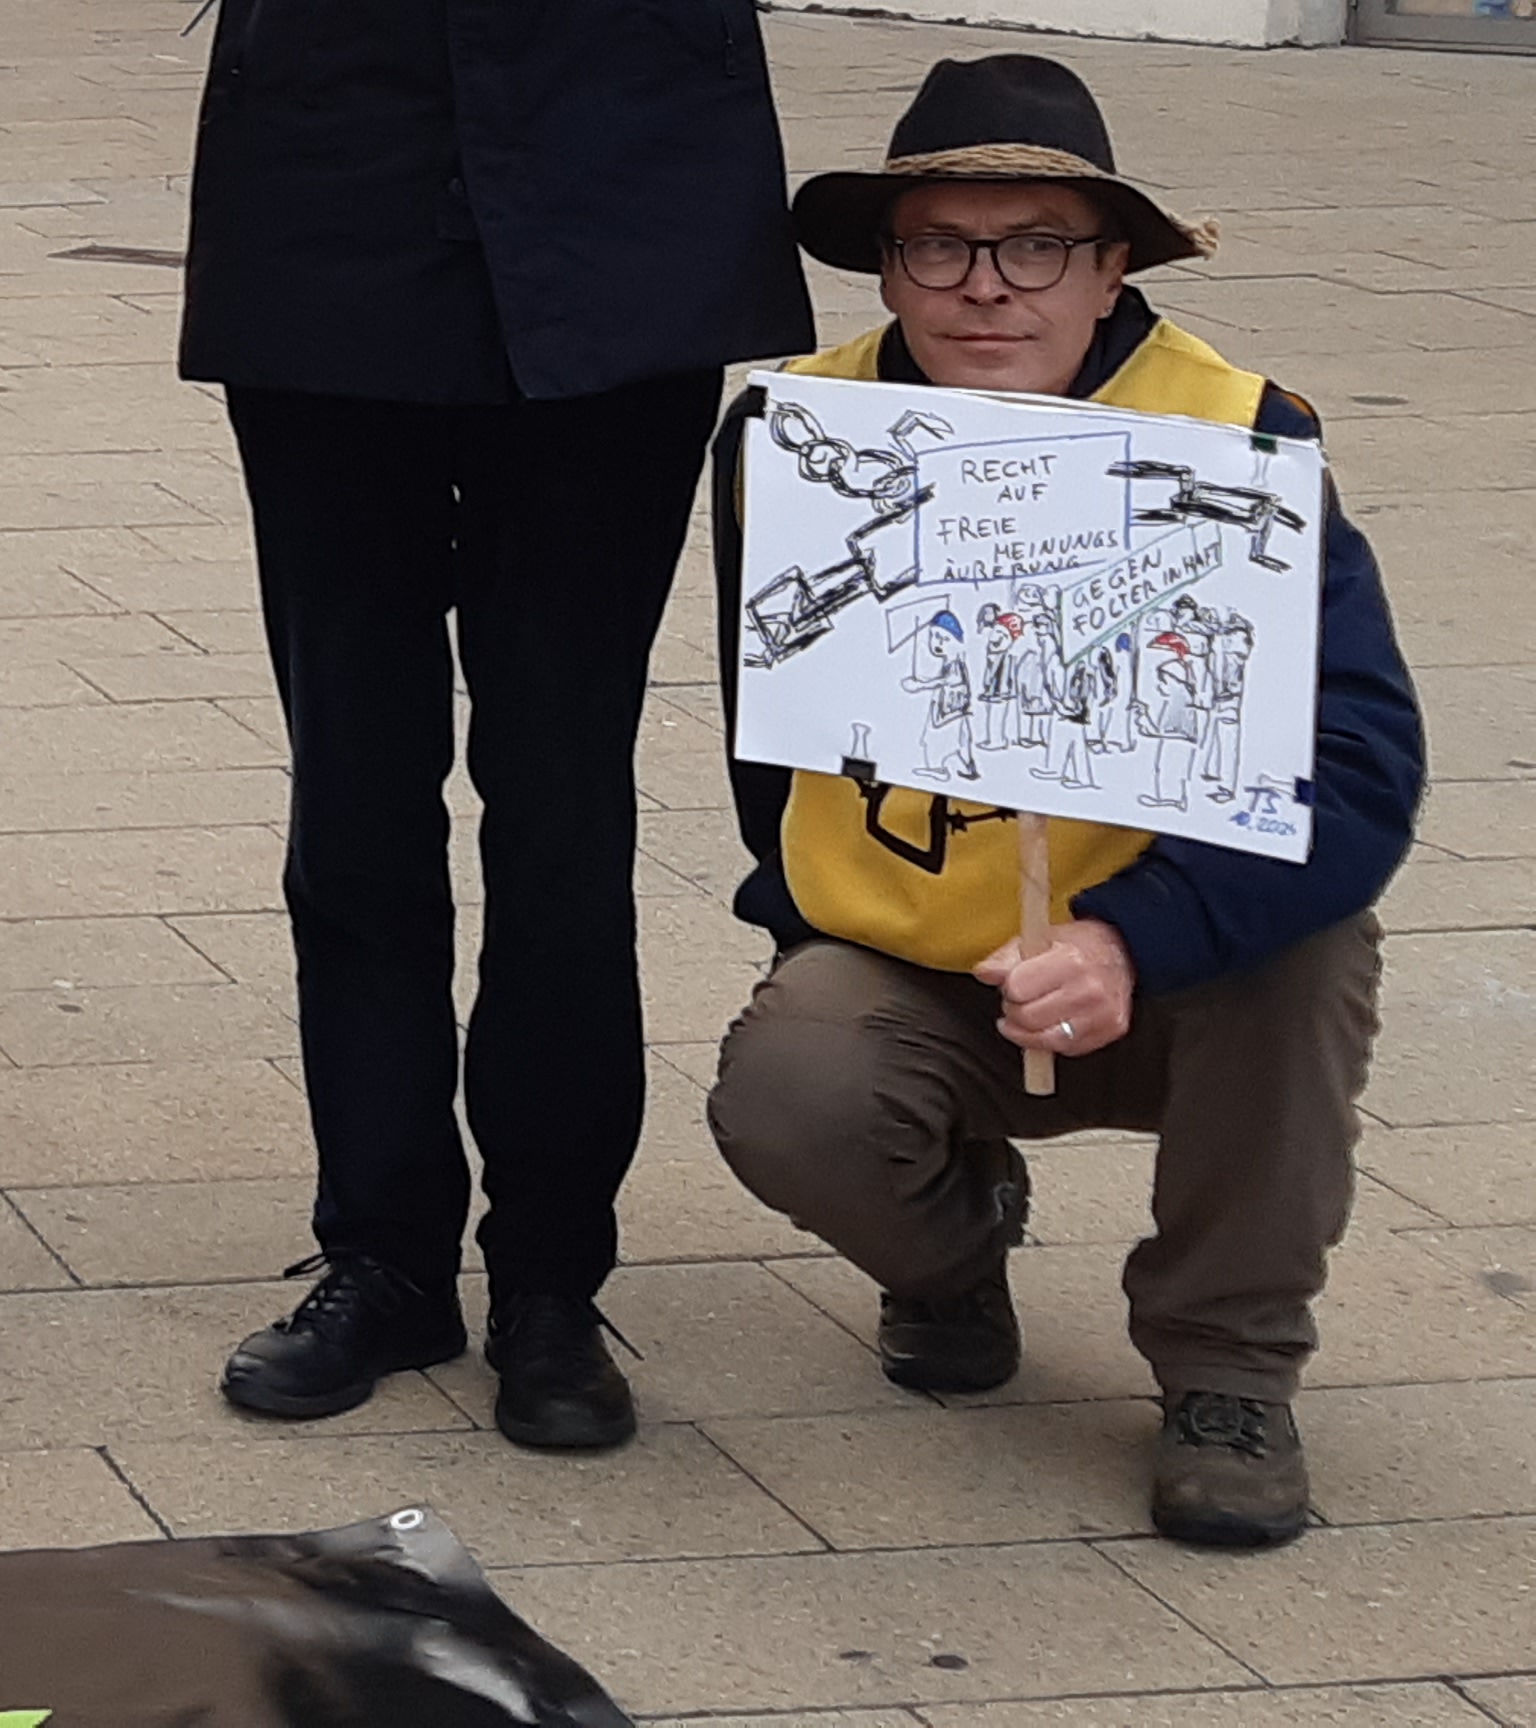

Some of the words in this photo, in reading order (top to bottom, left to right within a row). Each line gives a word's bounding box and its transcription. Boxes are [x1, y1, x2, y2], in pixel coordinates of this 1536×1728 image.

[961, 455, 1059, 485] RECHT
[996, 482, 1050, 503] AUF
[935, 517, 1018, 546] FREIE
[993, 529, 1120, 564] MEINUNGS
[1071, 548, 1164, 611] GEGEN
[1071, 579, 1159, 637] FOLTER
[1162, 562, 1183, 585] IN
